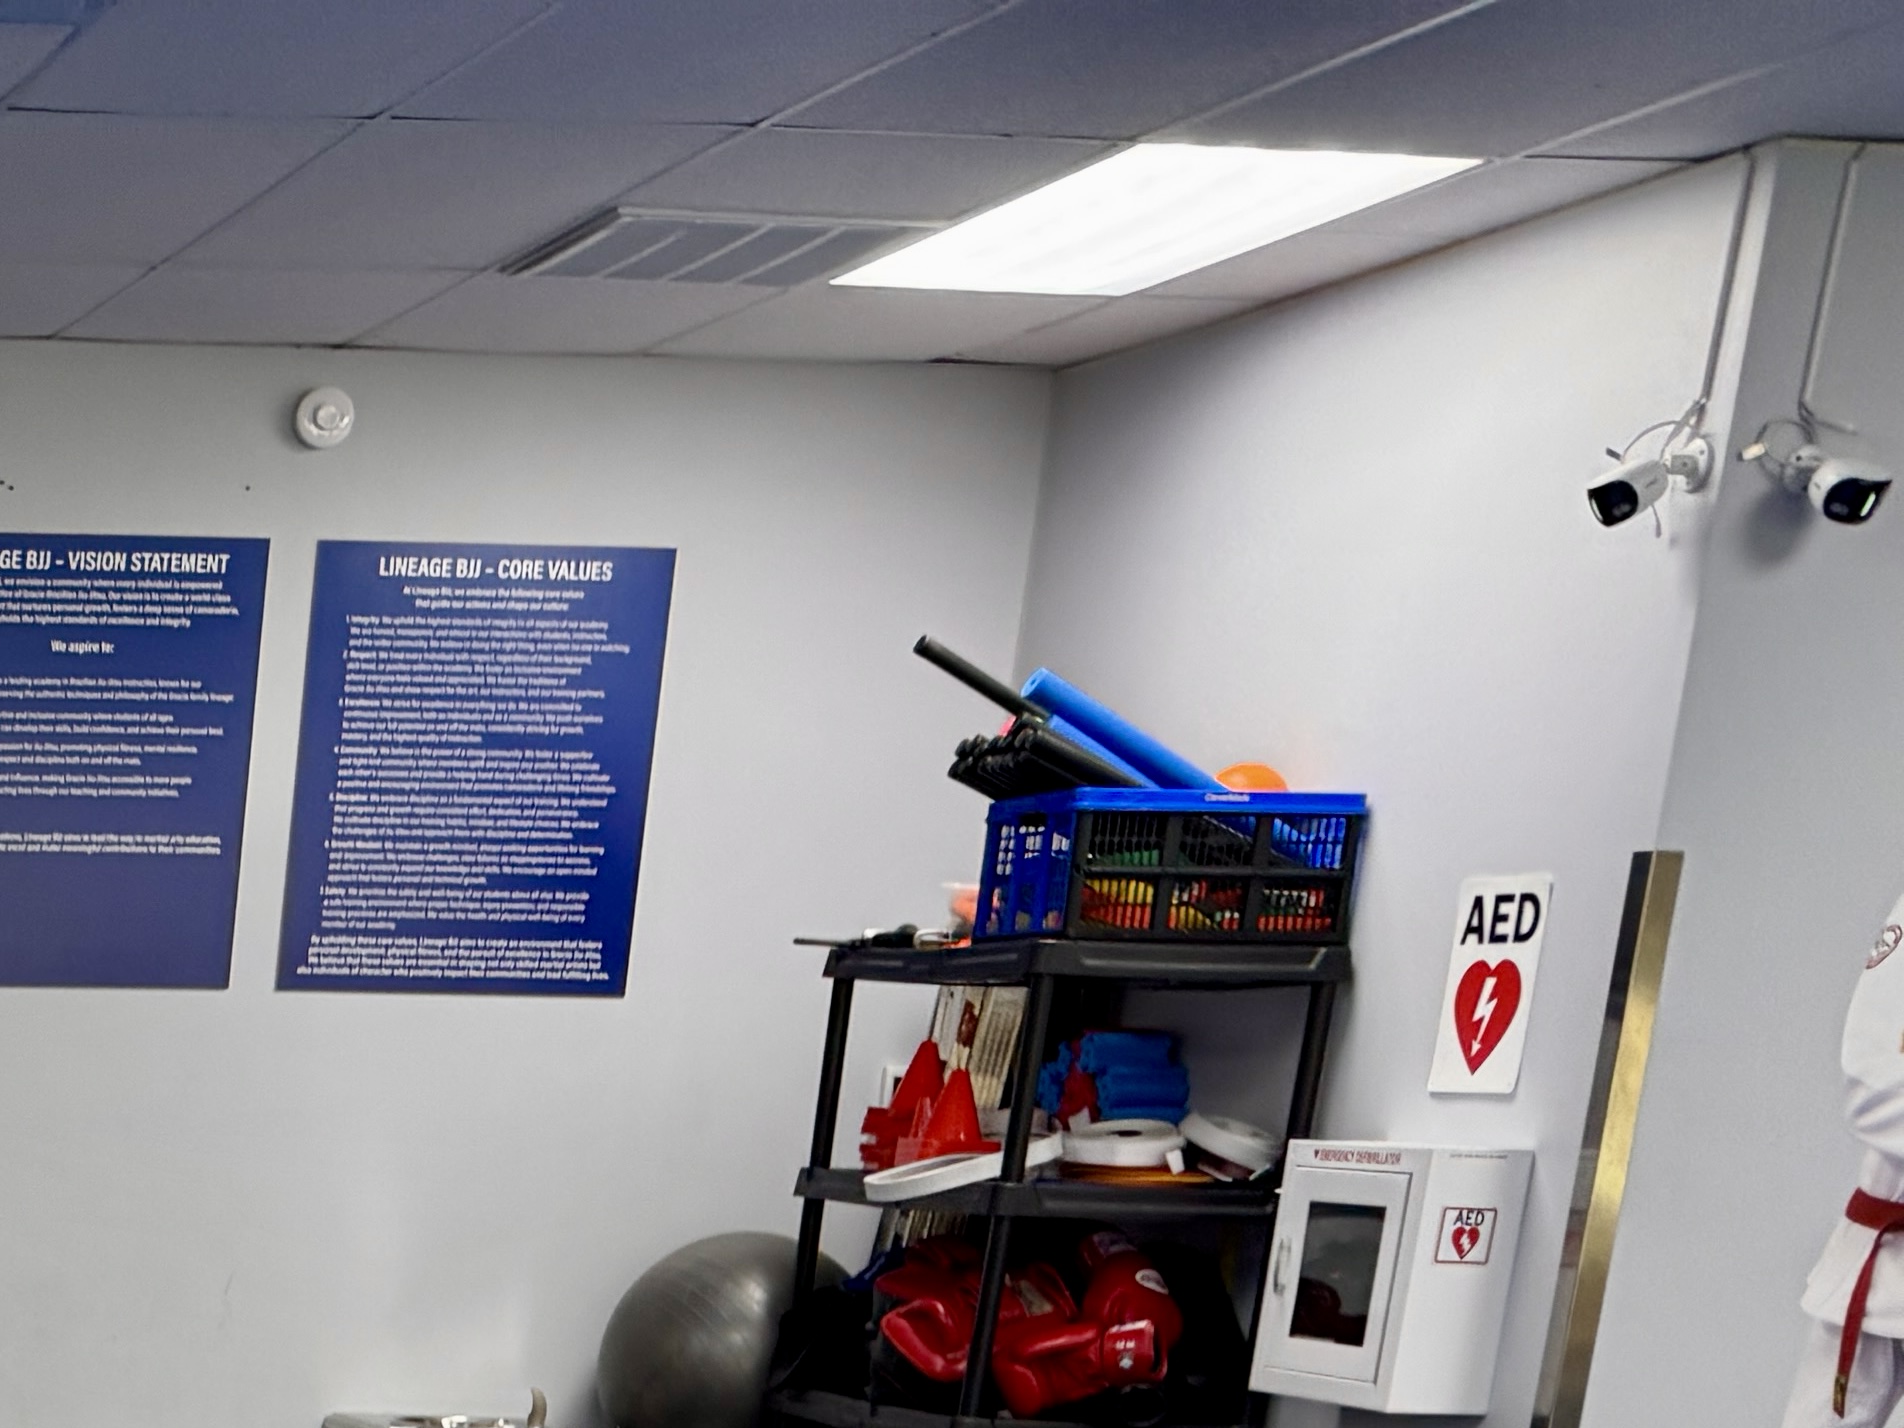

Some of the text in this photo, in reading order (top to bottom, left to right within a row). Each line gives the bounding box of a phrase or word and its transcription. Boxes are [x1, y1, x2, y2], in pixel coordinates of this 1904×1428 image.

[26, 550, 50, 570] BJJ
[68, 551, 126, 572] VISION
[130, 552, 230, 574] STATEMENT
[379, 556, 453, 578] LINEAGE
[456, 558, 481, 579] BJJ
[497, 559, 543, 580] CORE
[547, 560, 613, 582] VALUES
[1459, 891, 1542, 945] AED
[1453, 1209, 1486, 1227] AED
